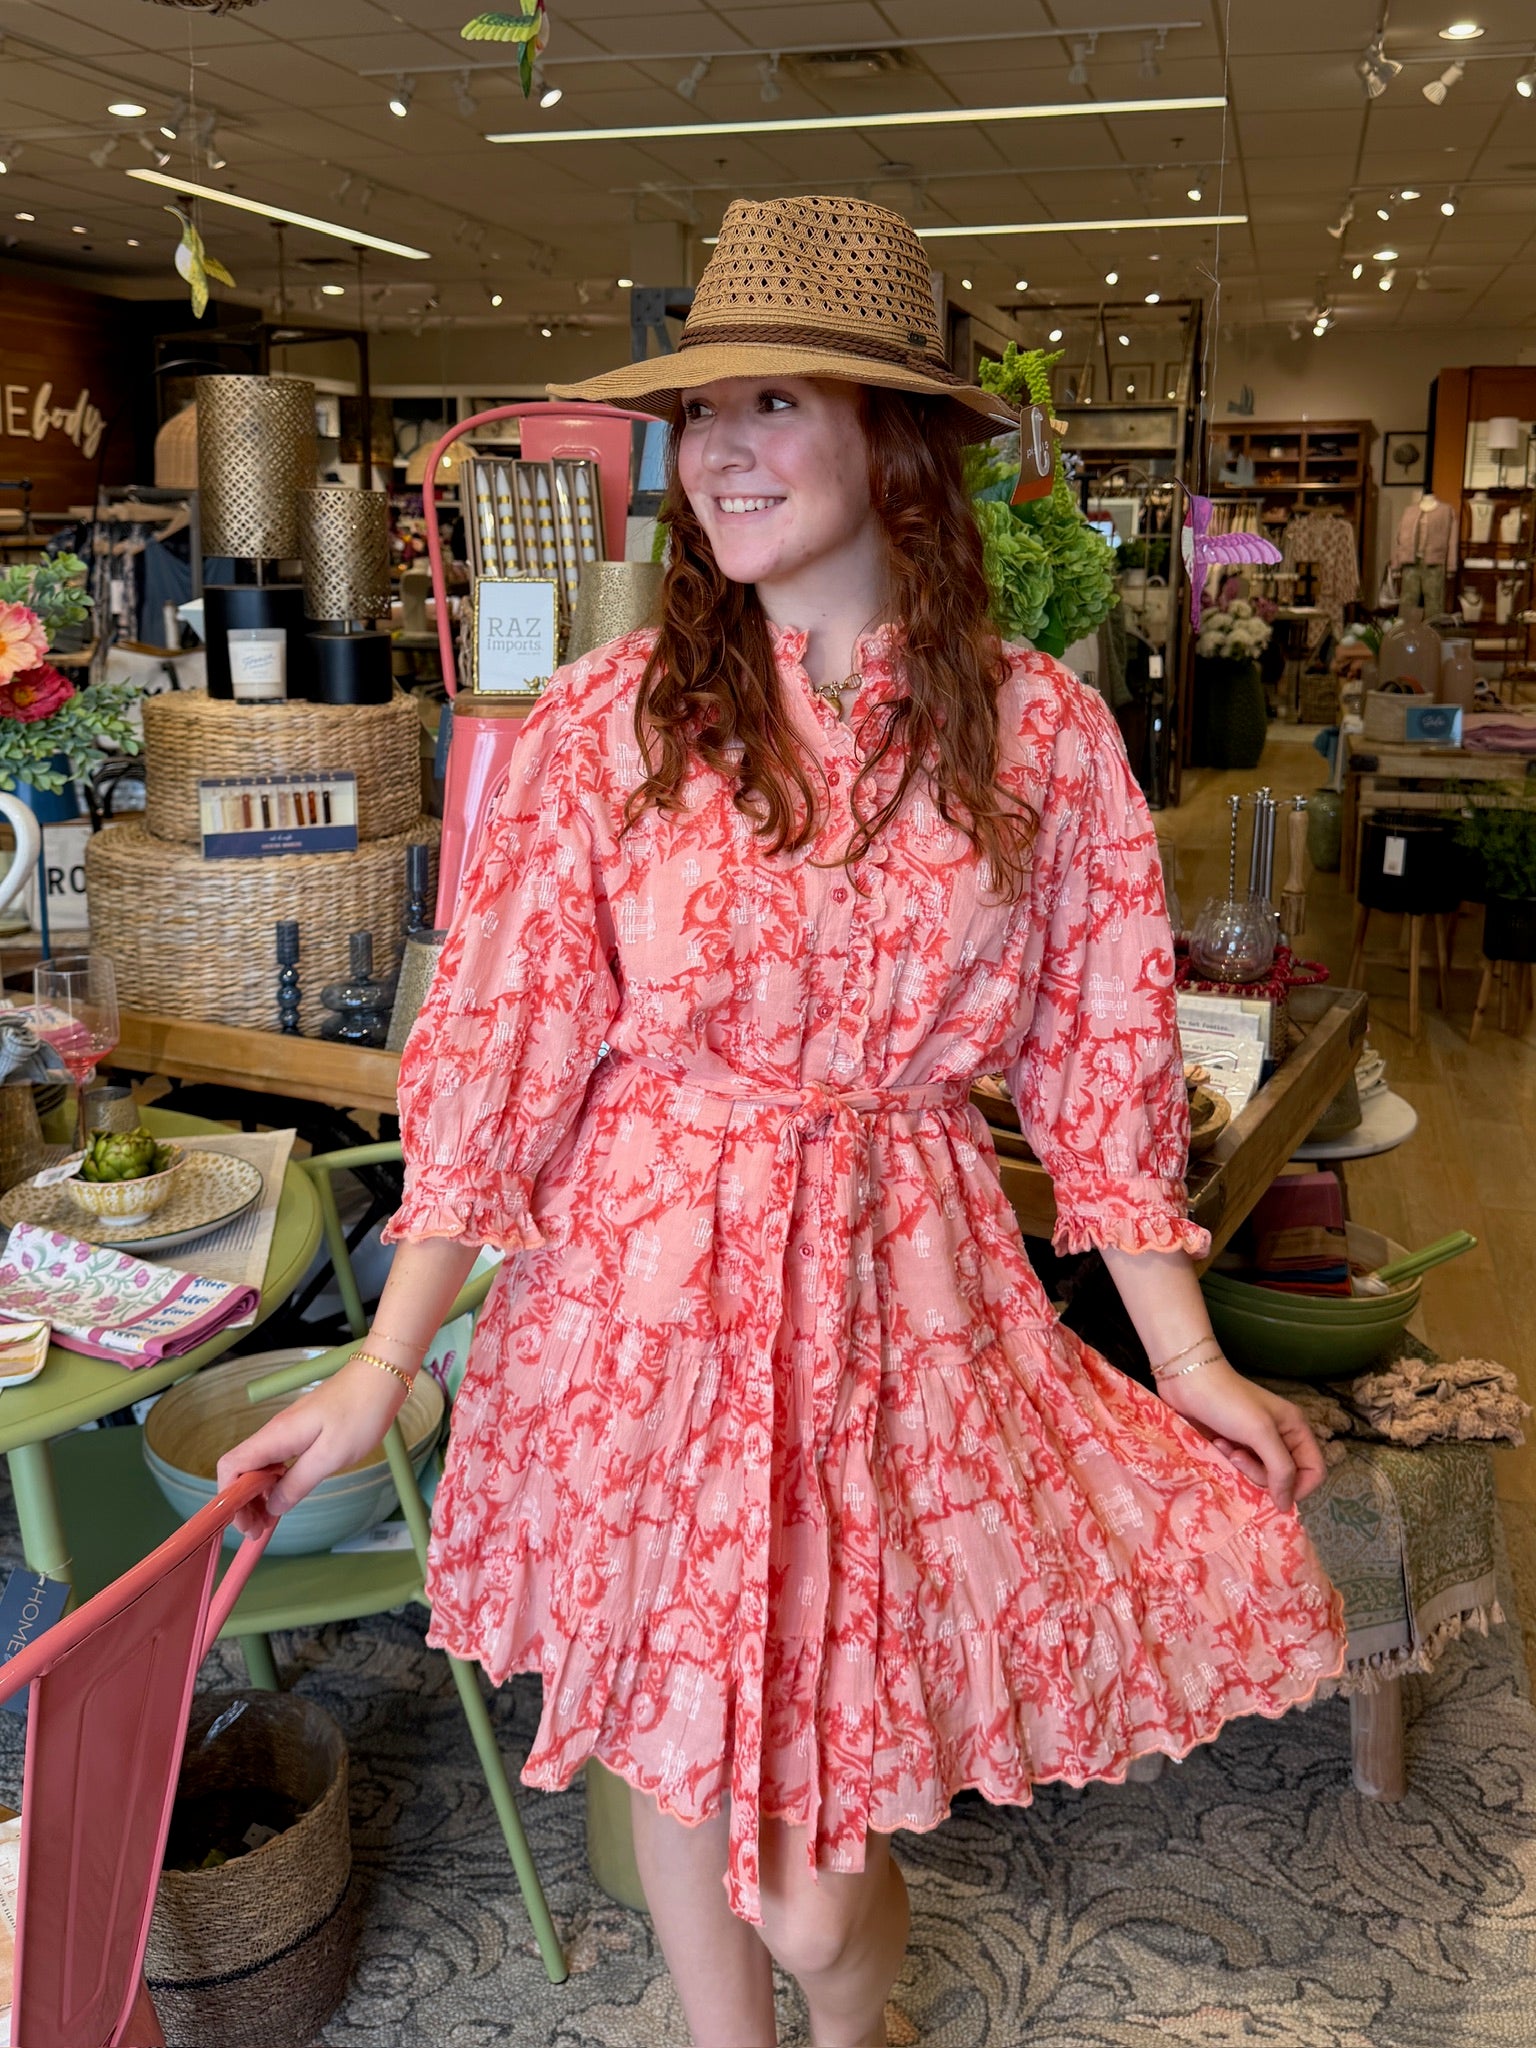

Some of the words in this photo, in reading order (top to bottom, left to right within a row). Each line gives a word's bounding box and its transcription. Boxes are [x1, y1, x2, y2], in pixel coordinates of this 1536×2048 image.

[0, 381, 107, 460] Ebody
[487, 616, 541, 638] RAZ
[487, 638, 542, 654] imports
